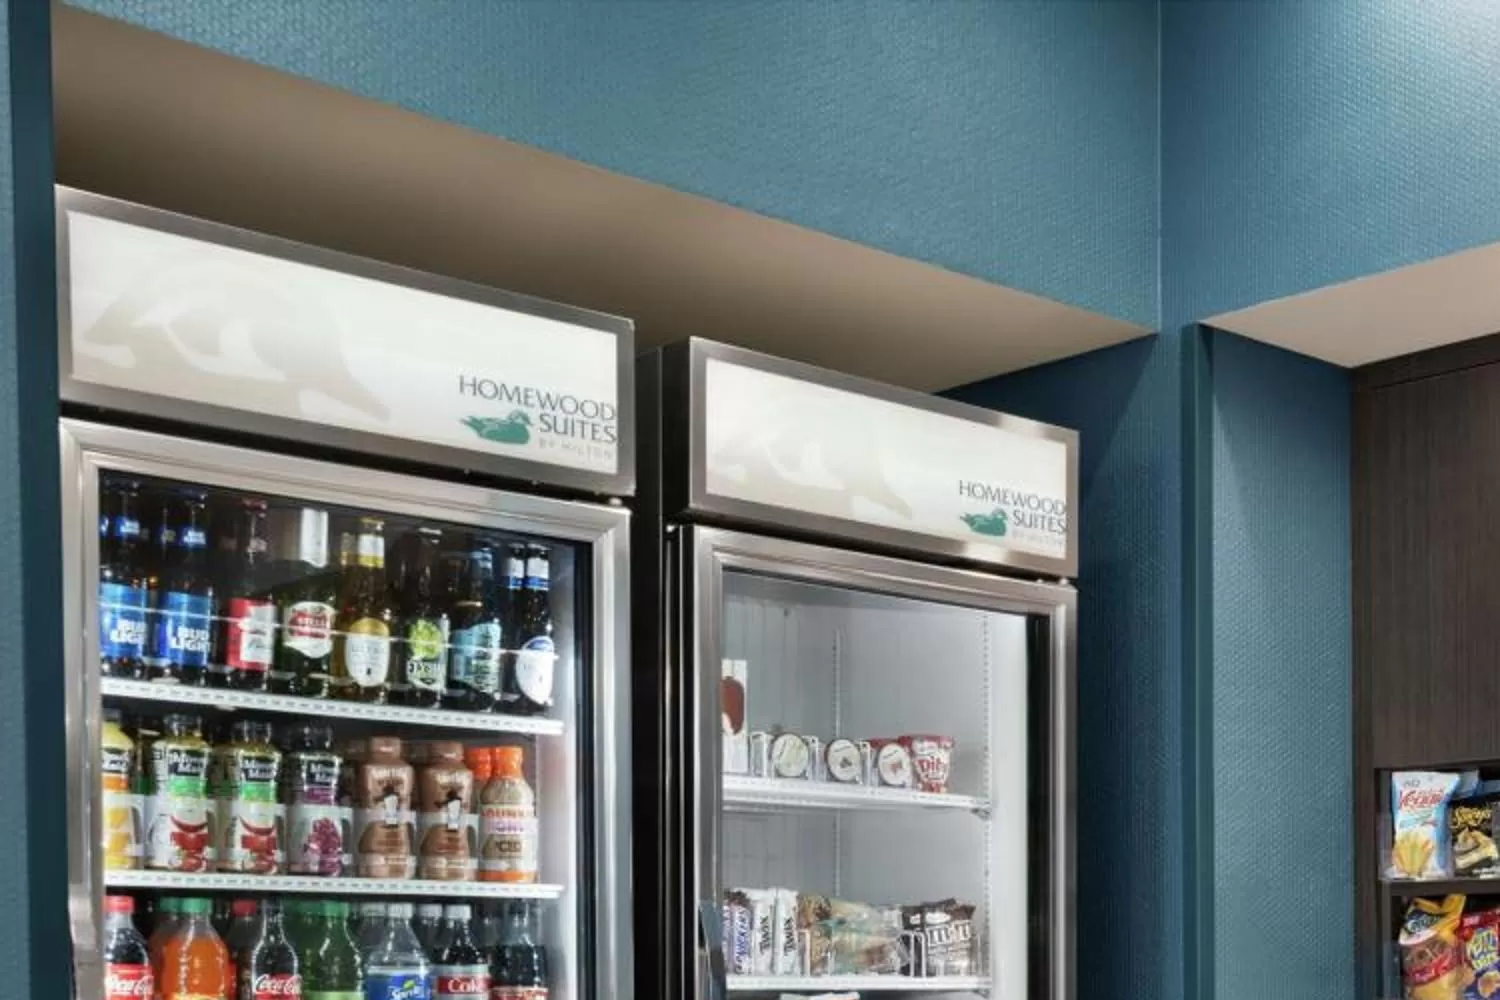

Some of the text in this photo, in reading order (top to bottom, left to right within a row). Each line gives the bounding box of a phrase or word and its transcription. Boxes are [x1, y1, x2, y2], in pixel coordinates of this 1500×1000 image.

[458, 374, 617, 421] HOMEWOOD
[539, 413, 617, 445] SUITES
[959, 480, 1066, 516] HOMEWOOD
[1013, 509, 1066, 535] SUITES
